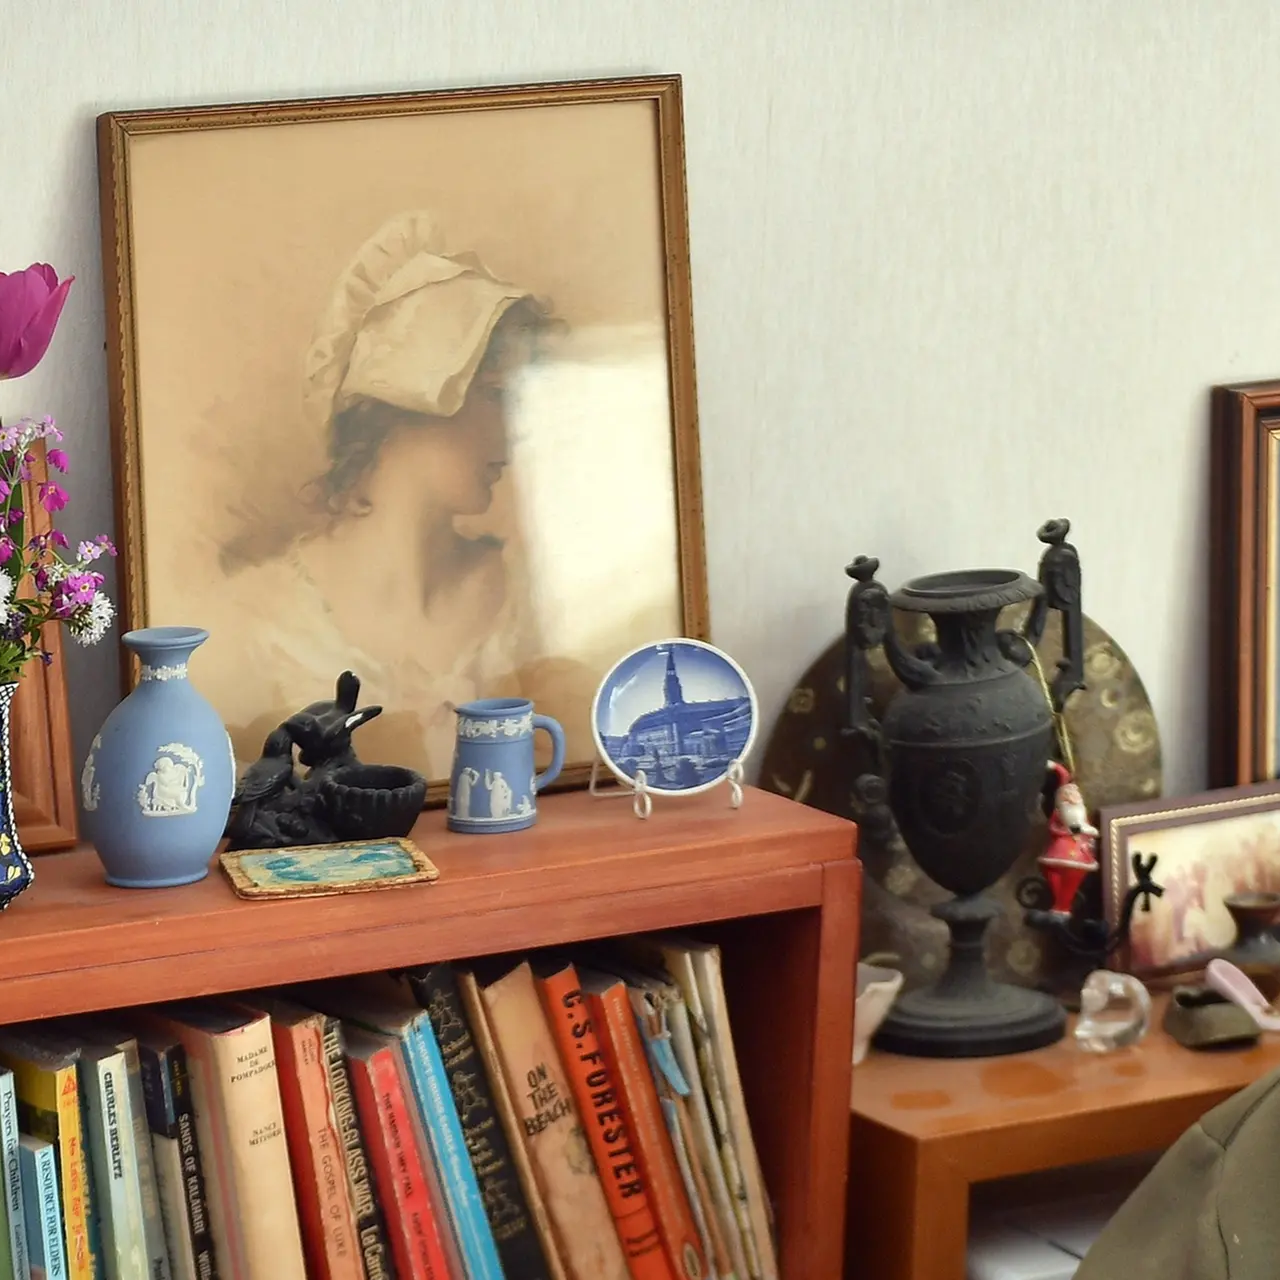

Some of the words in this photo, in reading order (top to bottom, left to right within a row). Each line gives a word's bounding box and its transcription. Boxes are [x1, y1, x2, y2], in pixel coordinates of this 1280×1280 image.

[236, 1045, 269, 1064] MADAME
[323, 1030, 341, 1062] THE
[527, 1062, 548, 1088] ON
[3, 1090, 15, 1136] Prayers
[103, 1071, 117, 1127] CHARLES
[383, 1092, 393, 1111] THE
[523, 1096, 572, 1137] BEACH
[527, 1082, 560, 1110] THE
[178, 1112, 194, 1157] SANDS
[317, 1127, 330, 1150] THE
[331, 1059, 368, 1185] LOOKING-GLASS
[5, 1138, 17, 1157] for
[109, 1127, 123, 1180] BERLITZ
[184, 1156, 196, 1172] OF
[7, 1157, 20, 1212] Children
[40, 1158, 58, 1214] RESOURCE
[322, 1155, 338, 1197] GOSPEL
[187, 1175, 205, 1235] KALAHARI
[328, 1204, 341, 1222] OF
[354, 1177, 375, 1220] WAR
[45, 1213, 58, 1238] FOR
[332, 1227, 346, 1258] LUKE
[48, 1238, 61, 1279] ELDERS
